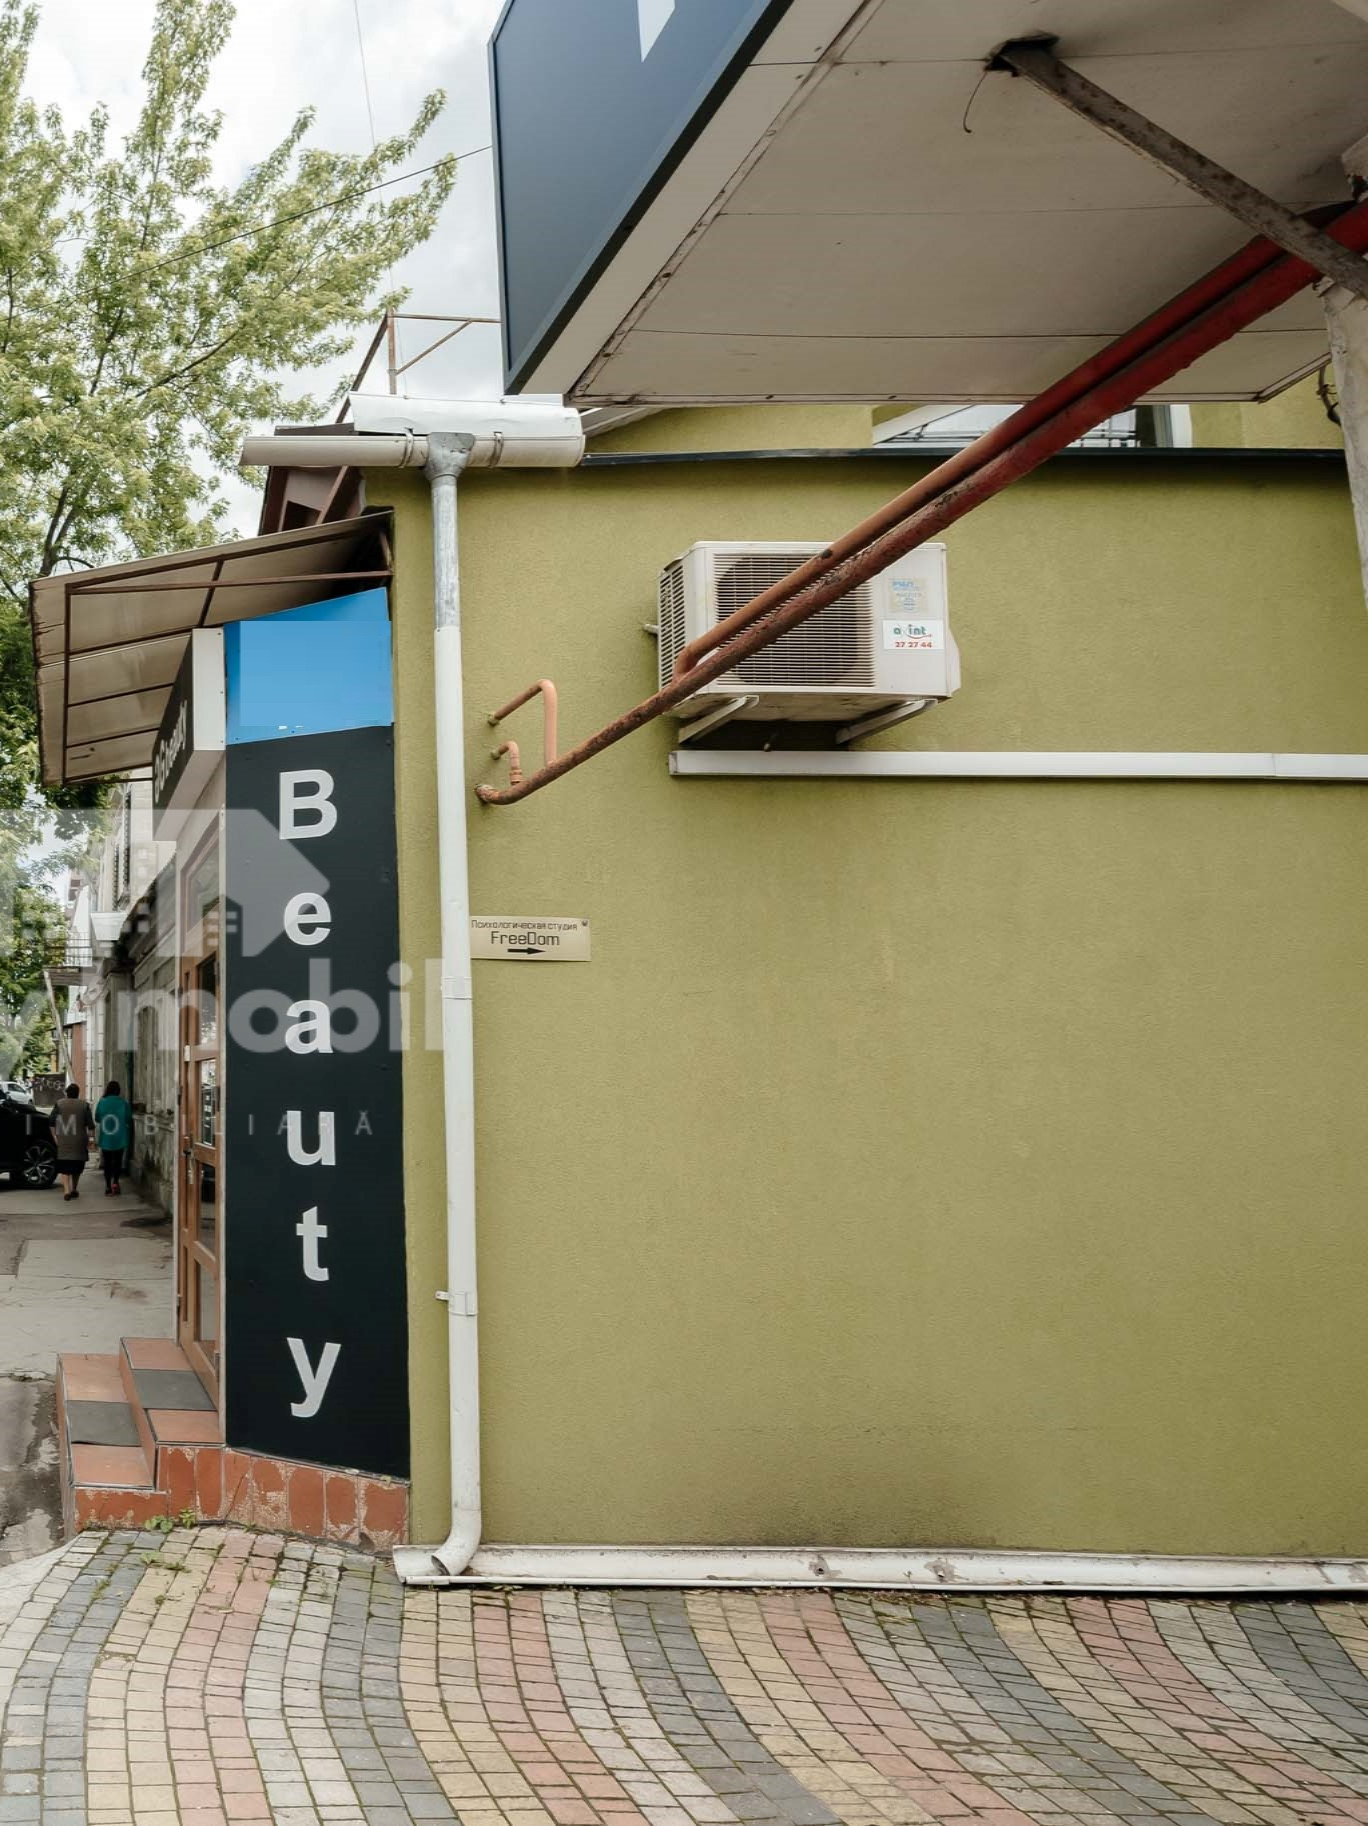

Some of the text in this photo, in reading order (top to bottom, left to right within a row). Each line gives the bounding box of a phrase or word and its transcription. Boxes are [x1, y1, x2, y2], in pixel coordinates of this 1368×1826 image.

[471, 919, 578, 932] Психологическая студия
[490, 930, 560, 946] FreeDom
[278, 768, 342, 1418] Beauty
